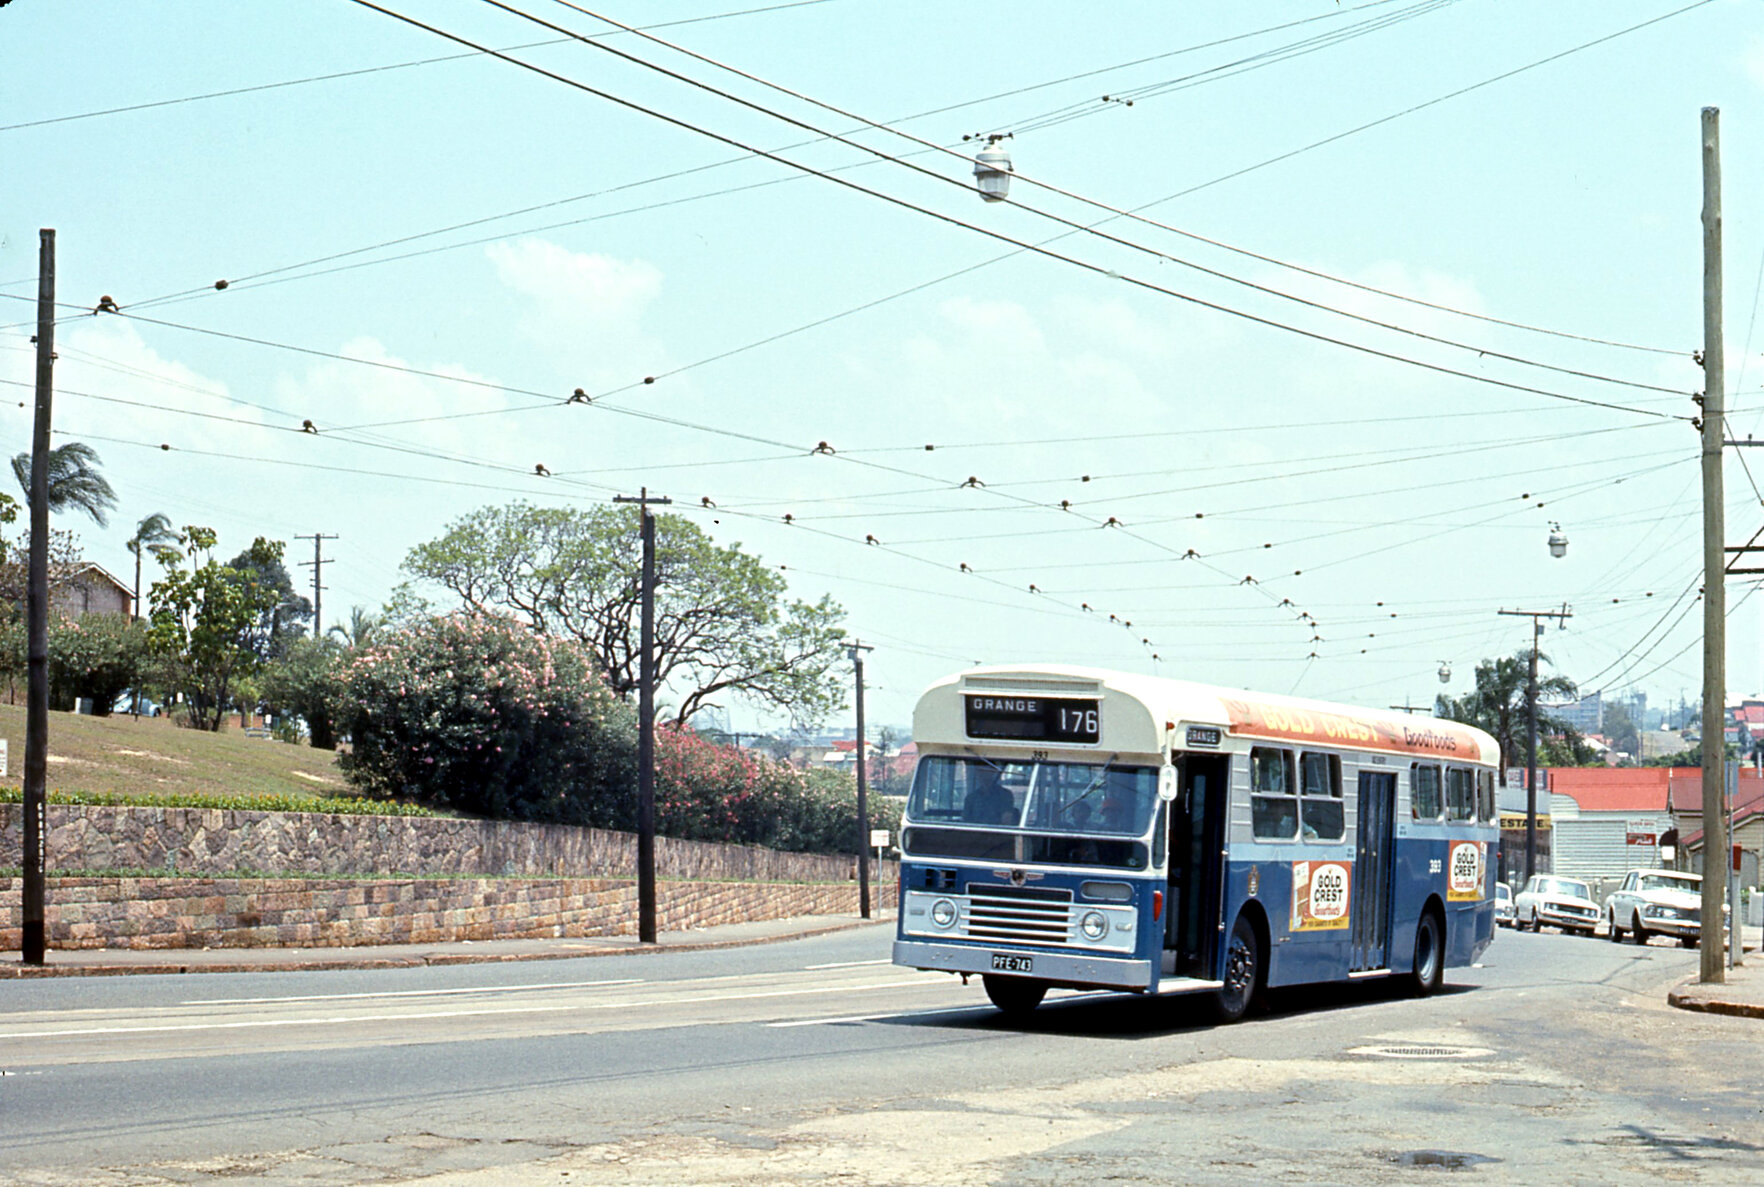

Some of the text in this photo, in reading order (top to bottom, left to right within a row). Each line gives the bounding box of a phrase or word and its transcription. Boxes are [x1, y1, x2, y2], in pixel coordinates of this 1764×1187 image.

[973, 698, 1037, 712] GRANGE
[1060, 708, 1098, 733] 176
[1261, 704, 1379, 742] GOLD CREST
[1500, 818, 1545, 828] ESTAE
[1456, 853, 1475, 864] GOLD
[1454, 864, 1476, 876] CREST
[1318, 875, 1342, 888] GOLD
[1314, 889, 1343, 902] CREST
